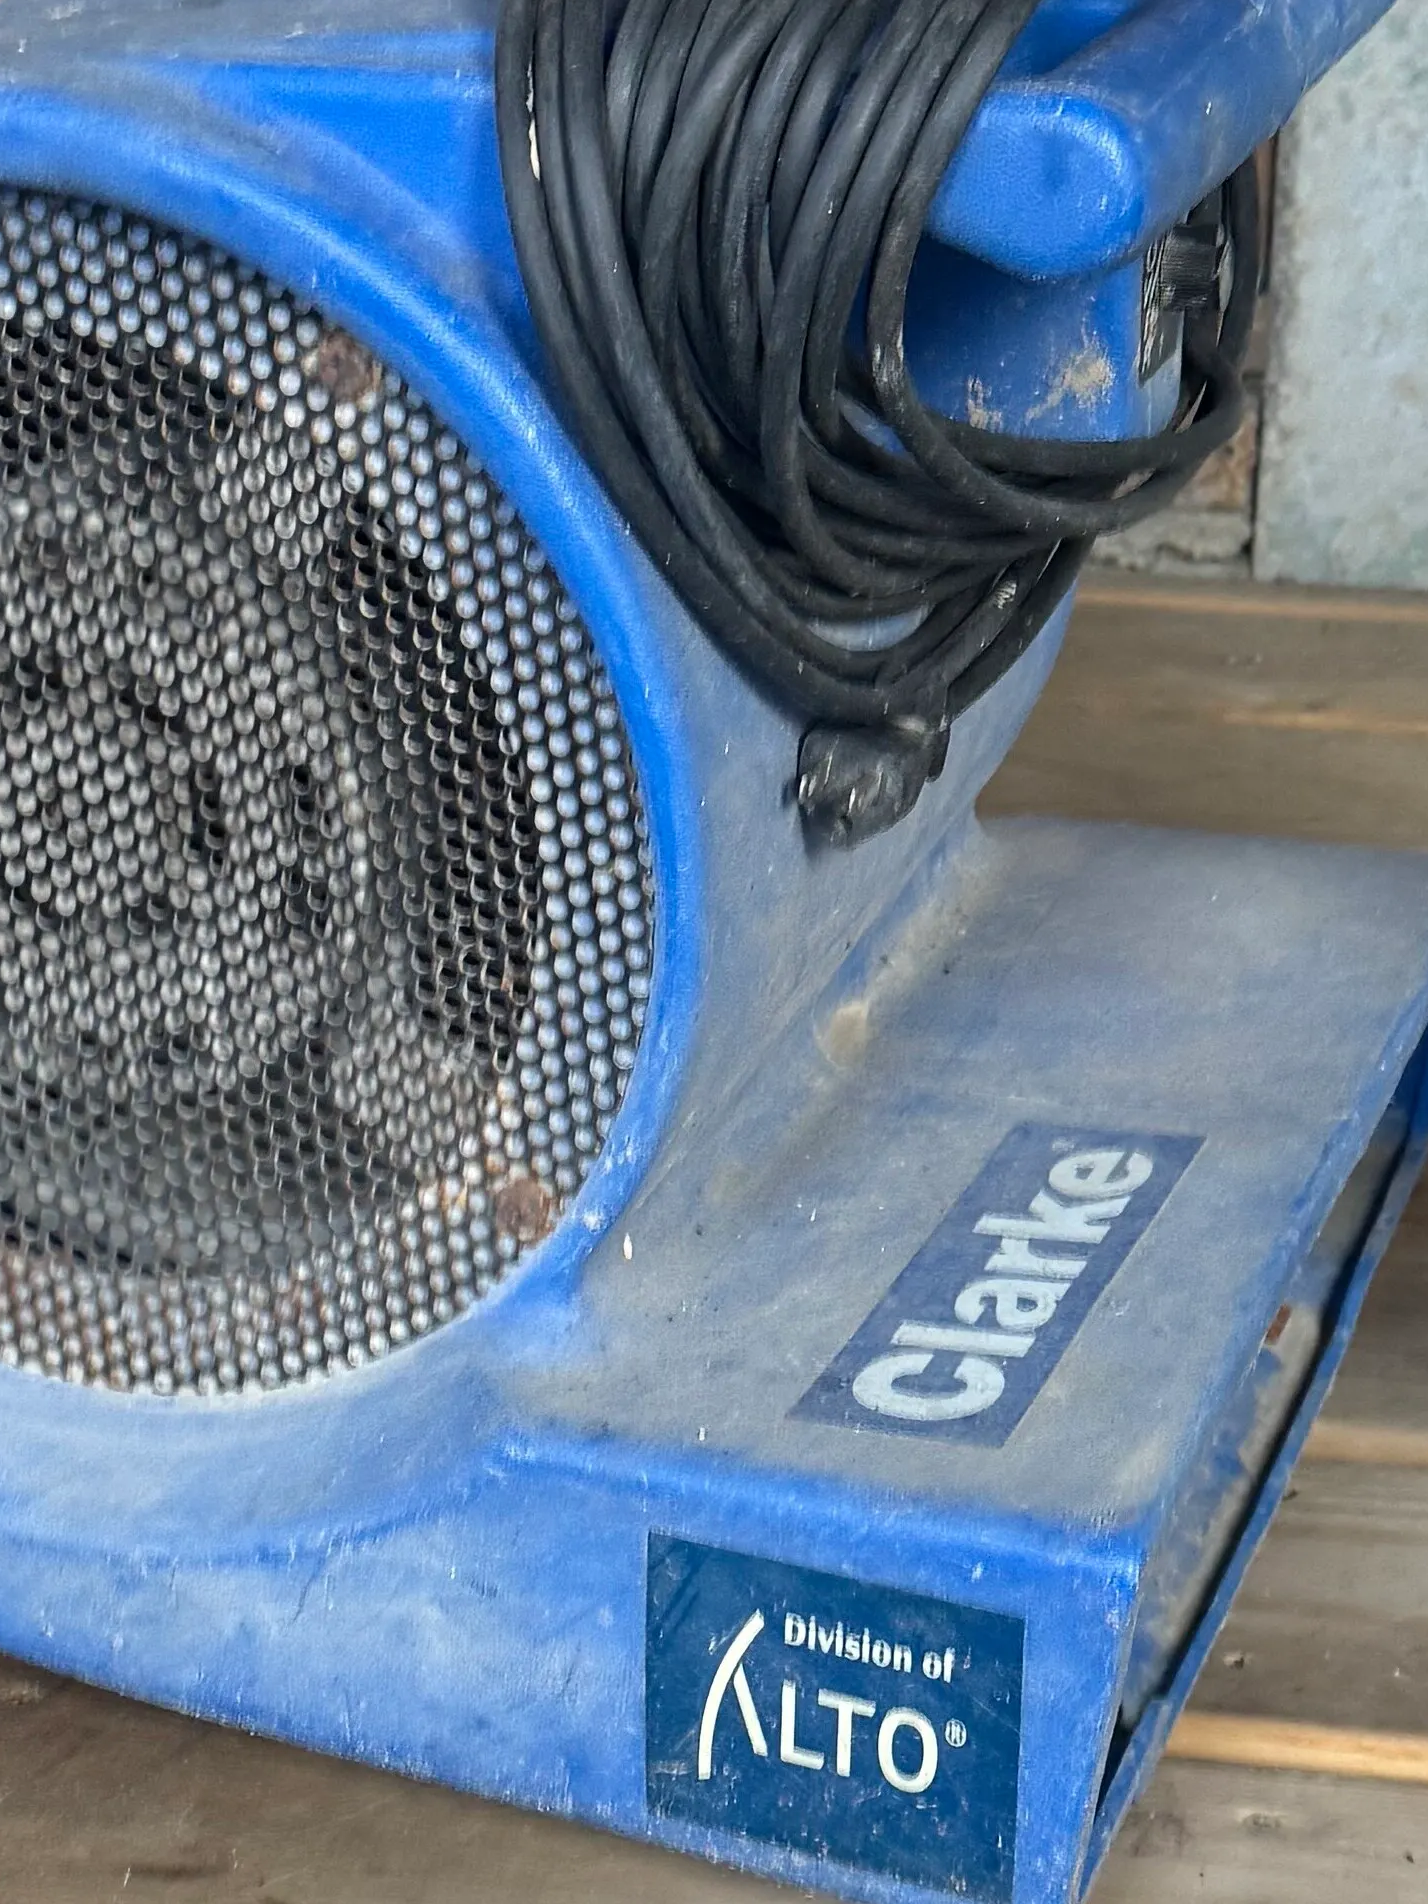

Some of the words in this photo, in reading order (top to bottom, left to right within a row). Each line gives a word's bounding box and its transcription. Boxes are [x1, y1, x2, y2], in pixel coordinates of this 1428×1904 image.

[852, 1148, 1154, 1421] Clarke
[784, 1612, 912, 1673] Division
[922, 1647, 956, 1683] of
